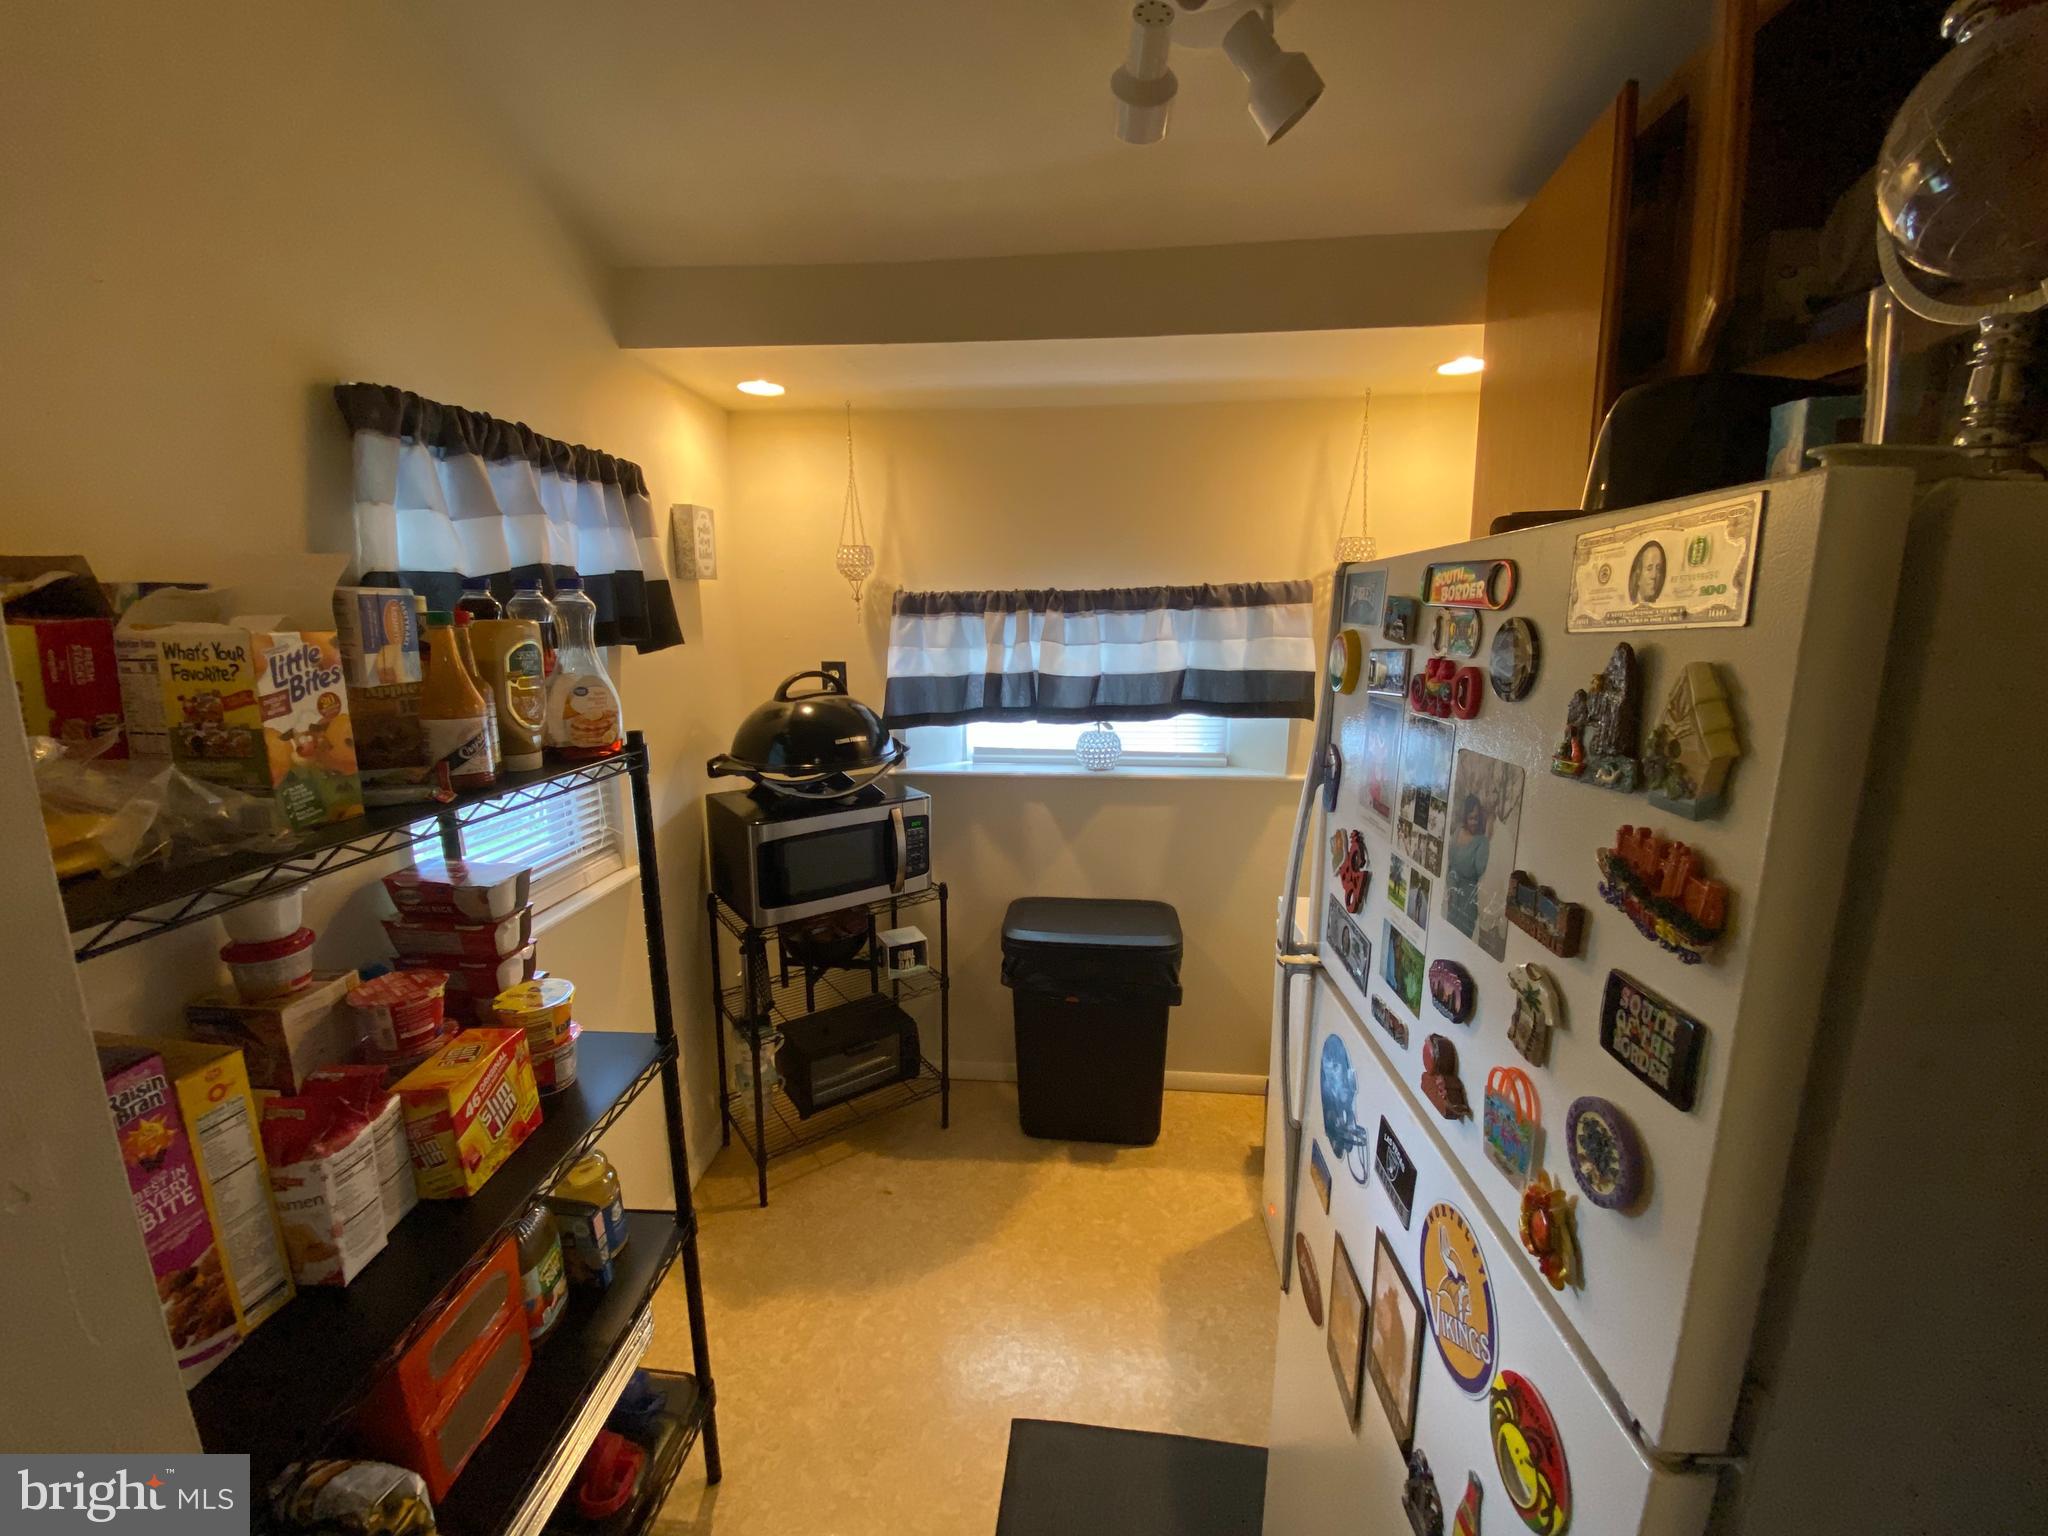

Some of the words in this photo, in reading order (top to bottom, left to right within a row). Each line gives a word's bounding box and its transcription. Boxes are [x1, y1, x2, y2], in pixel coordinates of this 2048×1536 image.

[1440, 580, 1485, 602] BORDER
[162, 642, 210, 662] What's
[269, 644, 321, 689] Little
[289, 665, 341, 703] Bites
[109, 1076, 166, 1112] Raisin
[465, 1092, 482, 1119] 46
[479, 1052, 508, 1093] ORIGINAL
[481, 1081, 513, 1127] slim
[116, 1091, 164, 1126] Bran
[134, 1177, 168, 1203] BEST
[170, 1164, 187, 1180] IN
[136, 1174, 190, 1215] EVERY
[138, 1186, 196, 1234] BITE
[1426, 1288, 1491, 1365] VIKINGS
